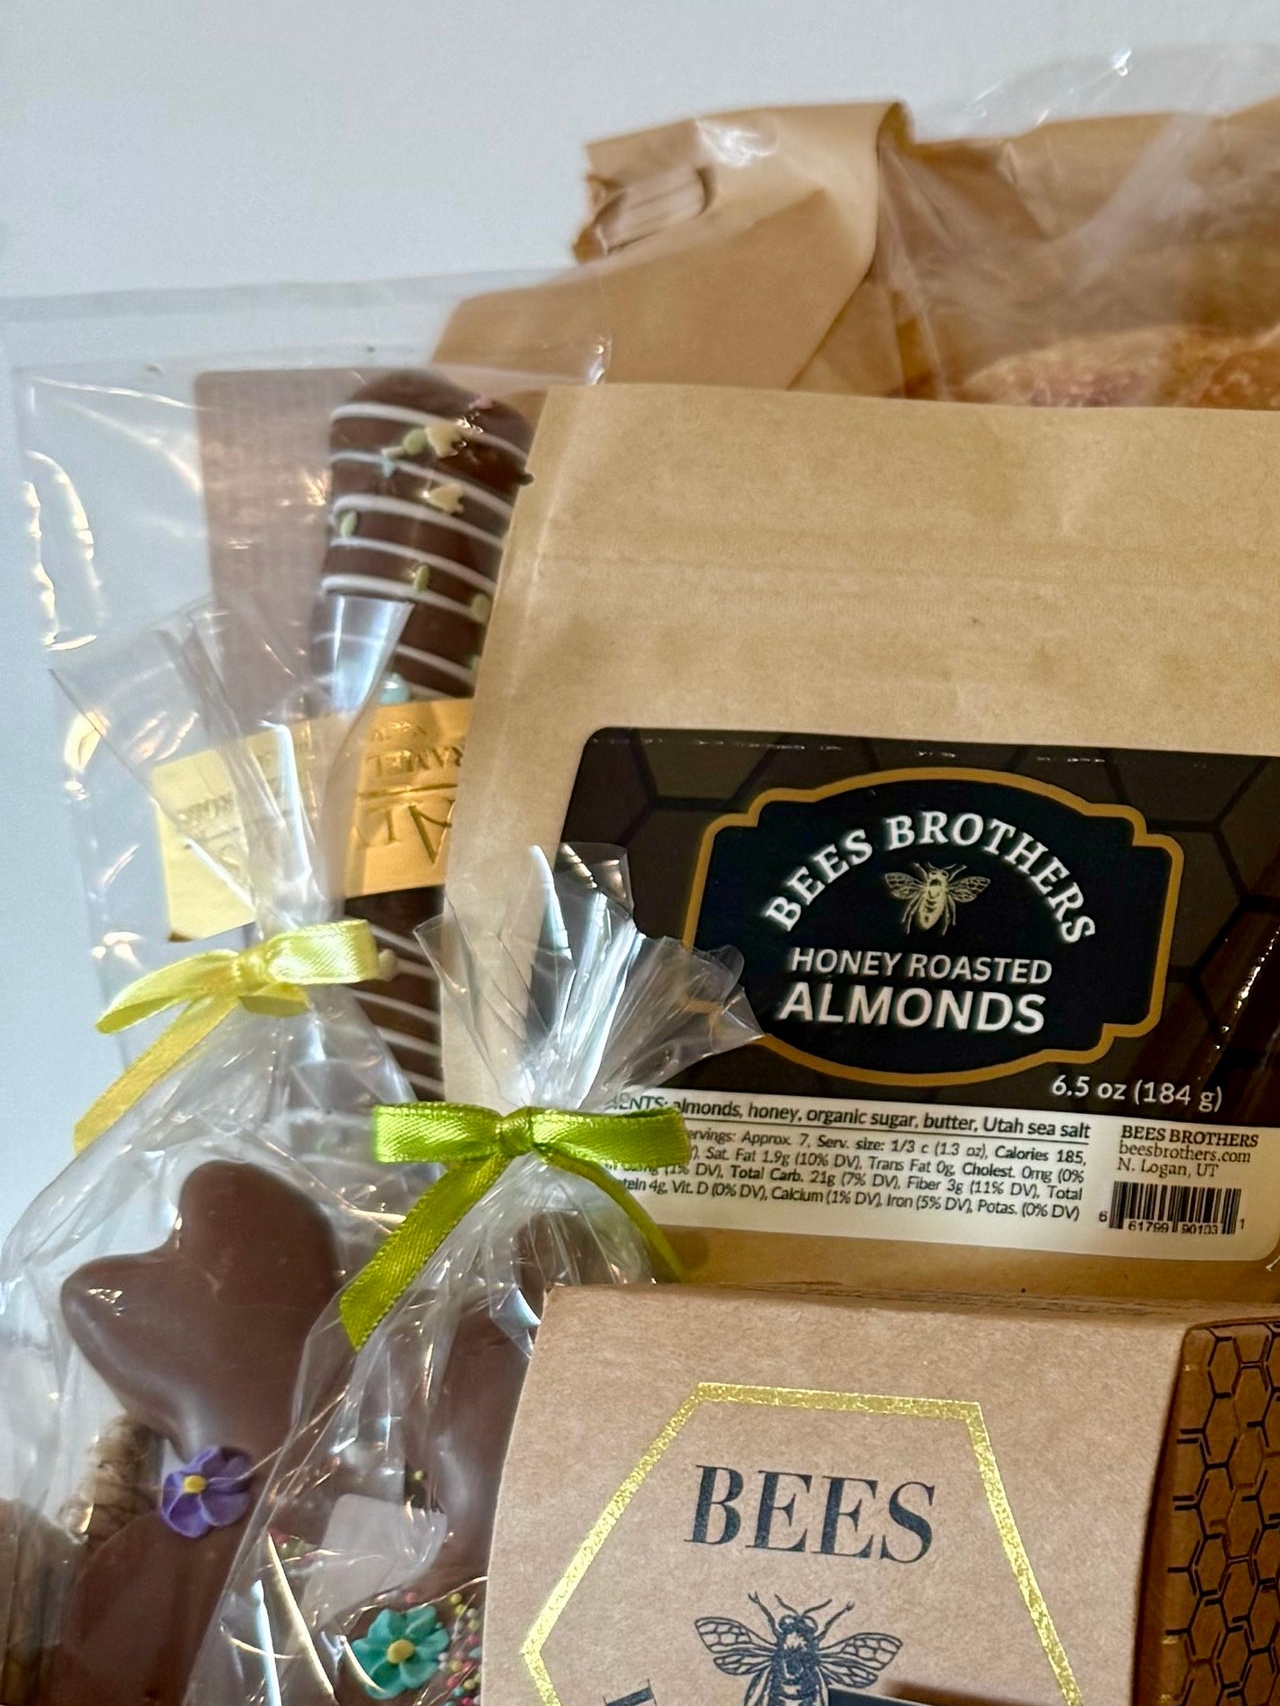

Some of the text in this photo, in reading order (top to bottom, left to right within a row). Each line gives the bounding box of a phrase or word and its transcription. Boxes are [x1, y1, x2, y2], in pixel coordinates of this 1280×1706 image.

[763, 810, 1096, 944] BEES BROTHERS
[790, 947, 1052, 985] HONEY ROASTED
[778, 981, 1047, 1035] ALMONDS
[1052, 1074, 1222, 1113] 6.5 oz (184 g)
[748, 1102, 803, 1123] honey,
[807, 1108, 867, 1125] organic
[923, 1112, 978, 1132] butter,
[983, 1116, 1024, 1134] Utah
[1027, 1122, 1056, 1136] sea
[1060, 1122, 1092, 1139] salt
[1121, 1124, 1259, 1148] BEES BROTHERS
[735, 1147, 756, 1162] Fat
[762, 1150, 790, 1167] 1.9g
[795, 1152, 829, 1167] (10%
[869, 1156, 905, 1171] Trans
[910, 1158, 931, 1174] Fat
[1022, 1166, 1053, 1184] 0mg
[1058, 1168, 1085, 1184] (0%
[855, 1137, 885, 1152] size:
[891, 1139, 915, 1153] 1/3
[920, 1144, 929, 1154] c
[995, 1145, 1049, 1161] Calories
[1057, 1150, 1087, 1166] 185,
[1117, 1157, 1219, 1179] N. Logan, UT
[1119, 1139, 1251, 1163] beesbrothers.com
[731, 1164, 765, 1180] Total
[810, 1169, 836, 1187] 21g
[841, 1171, 866, 1186] (7%
[907, 1175, 942, 1191] Fiber
[947, 1179, 963, 1195] 3g
[970, 1179, 1004, 1196] (11%
[1047, 1184, 1082, 1201] Total
[697, 1183, 709, 1194] D
[711, 1184, 737, 1198] (0%
[771, 1186, 824, 1203] Calcium
[826, 1189, 851, 1205] (1%
[886, 1193, 914, 1208] Iron
[916, 1195, 941, 1211] (5%
[1022, 1202, 1048, 1219] (0%
[1052, 1204, 1081, 1222] DV)
[1098, 1209, 1108, 1223] 6
[683, 1463, 936, 1564] BEES
